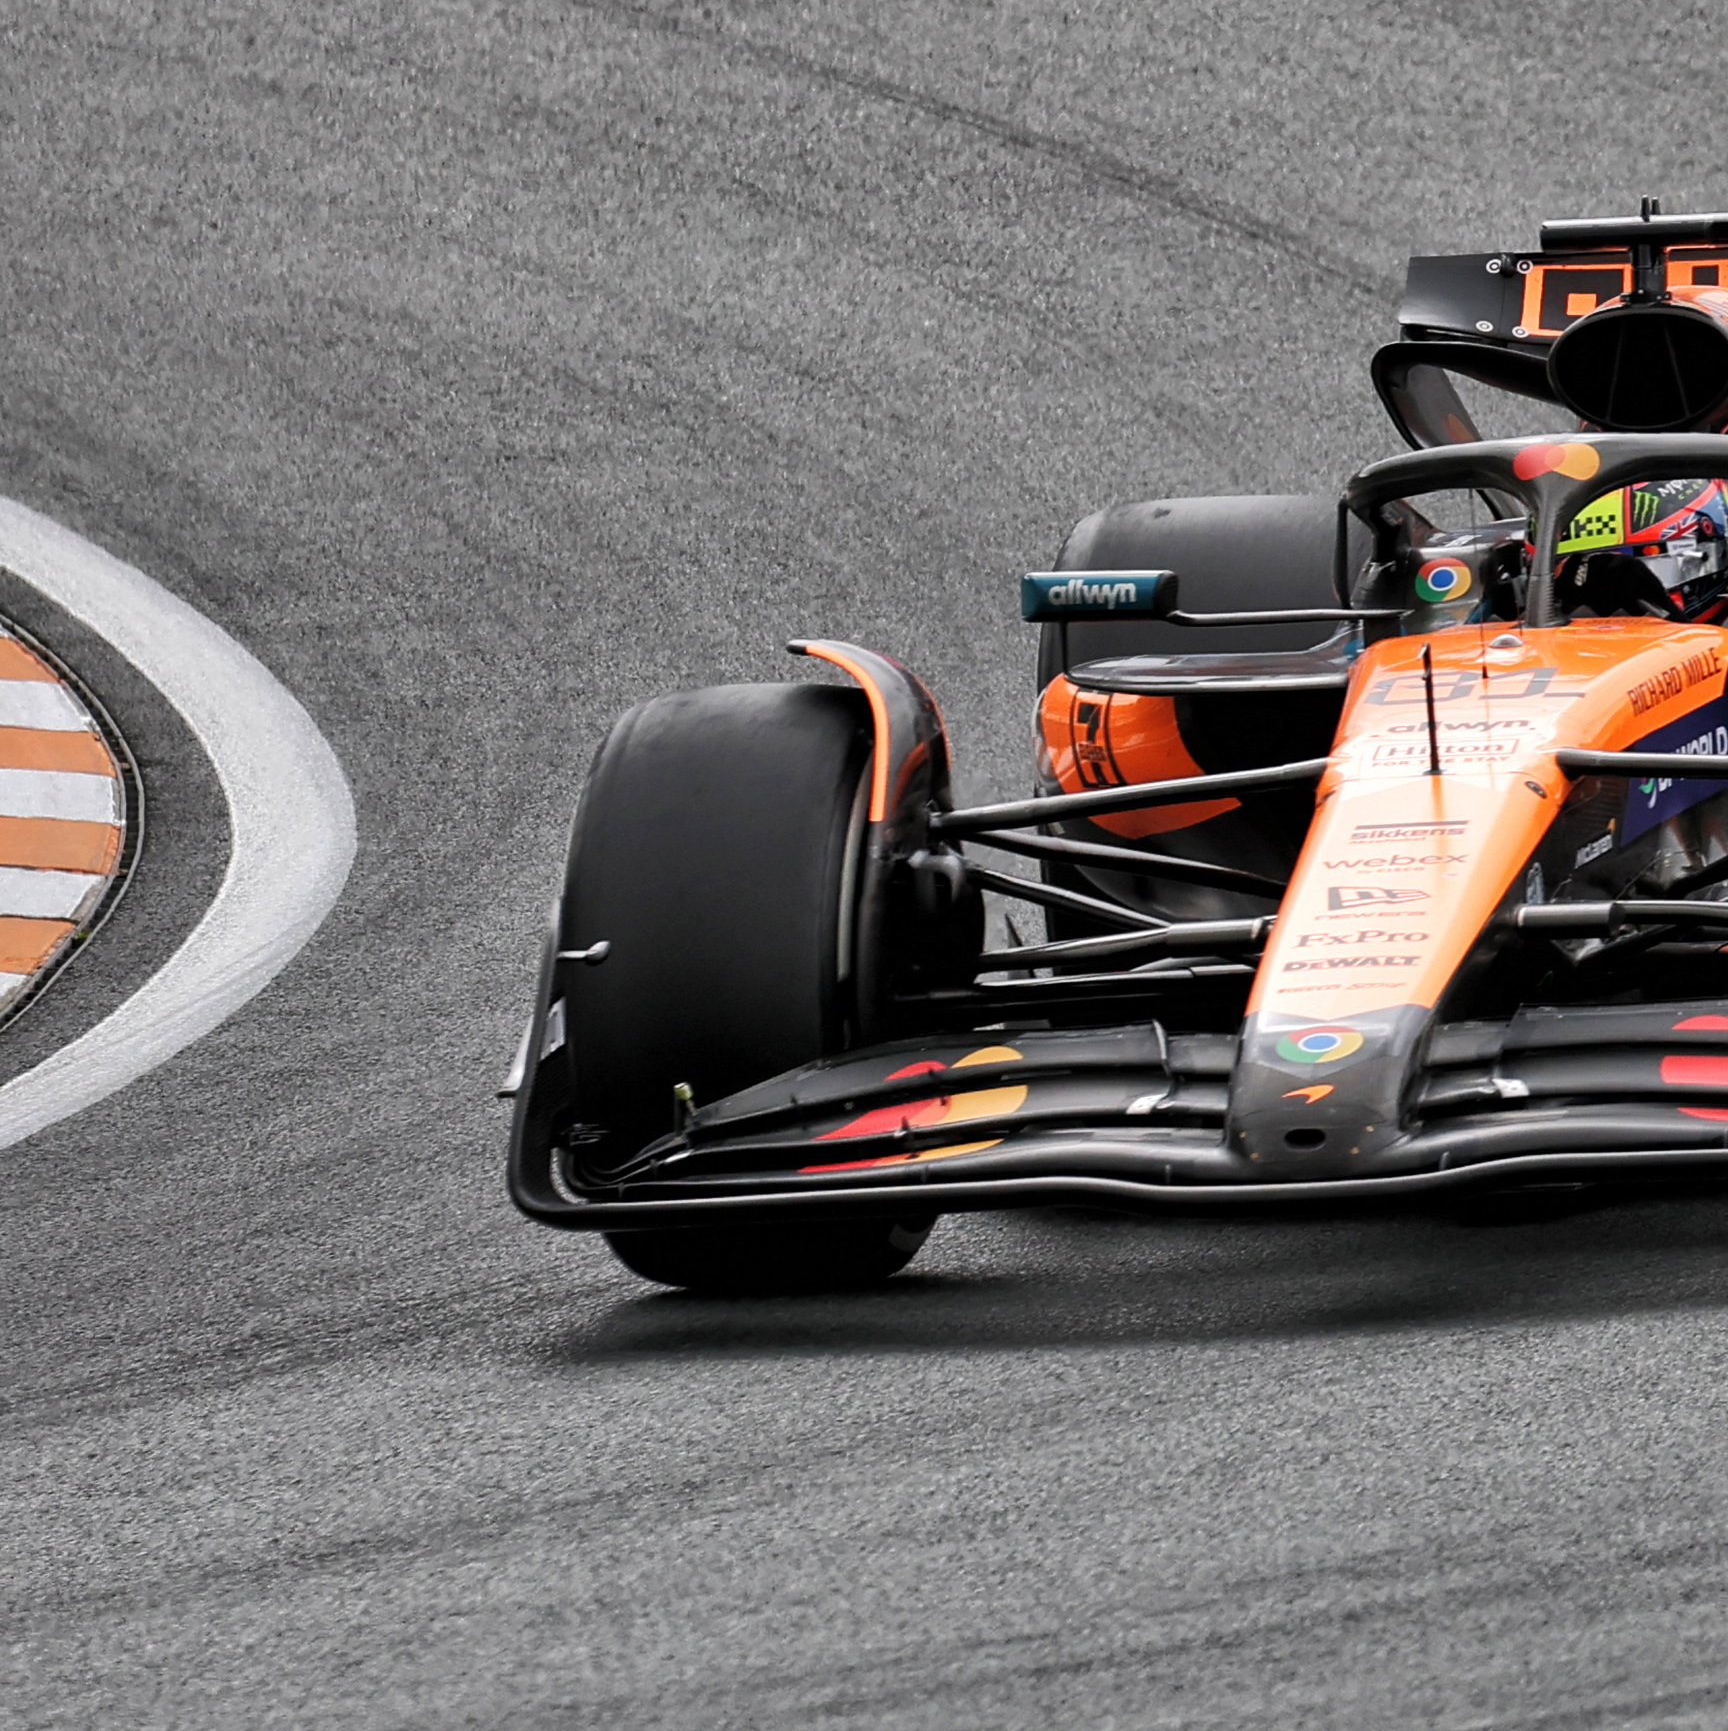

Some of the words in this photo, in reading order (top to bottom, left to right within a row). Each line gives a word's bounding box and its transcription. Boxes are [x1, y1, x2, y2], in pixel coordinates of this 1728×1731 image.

[1571, 514, 1617, 539] KX
[1048, 579, 1137, 610] allwyn
[1627, 667, 1682, 717] RICHARD
[1681, 646, 1722, 687] MILLE
[1387, 720, 1530, 733] alwyn
[1387, 744, 1504, 757] Hiton
[1672, 726, 1728, 756] ORLD
[1323, 853, 1471, 869] webex
[1292, 929, 1430, 948] FxPro
